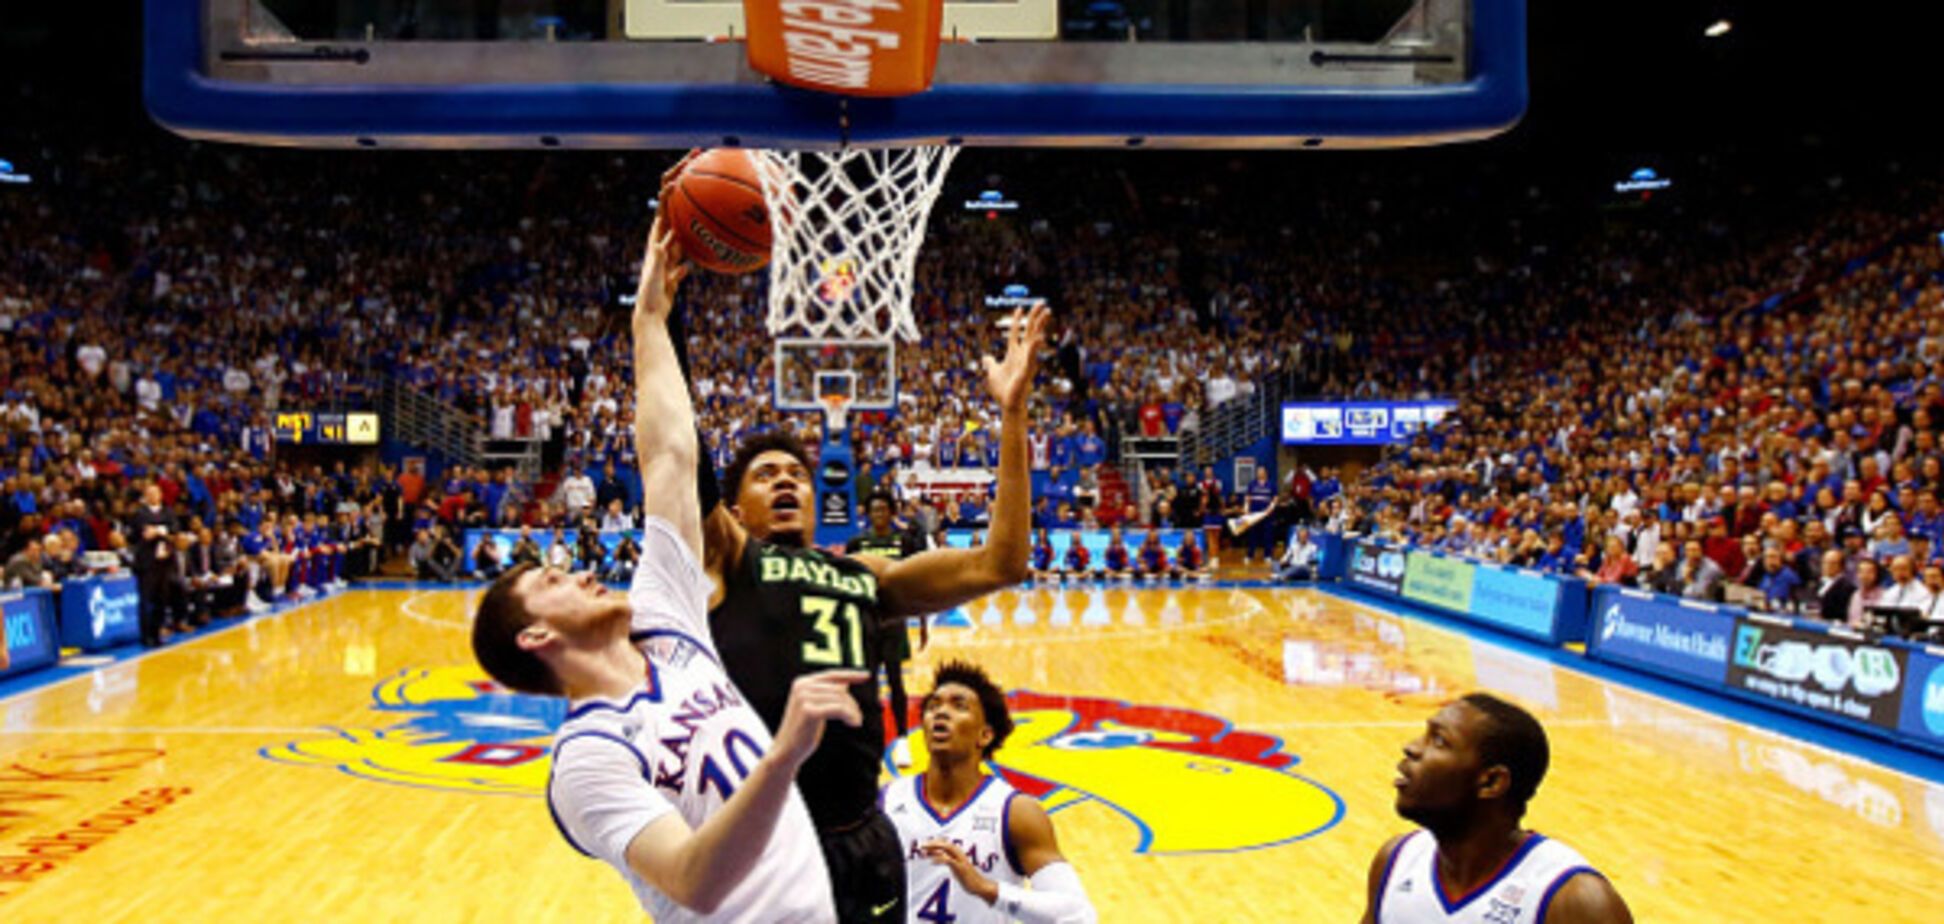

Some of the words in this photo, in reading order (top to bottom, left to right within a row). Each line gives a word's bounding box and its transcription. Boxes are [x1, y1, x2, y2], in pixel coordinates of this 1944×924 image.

[801, 596, 865, 668] 31
[696, 728, 766, 803] 10
[917, 877, 957, 924] 4
